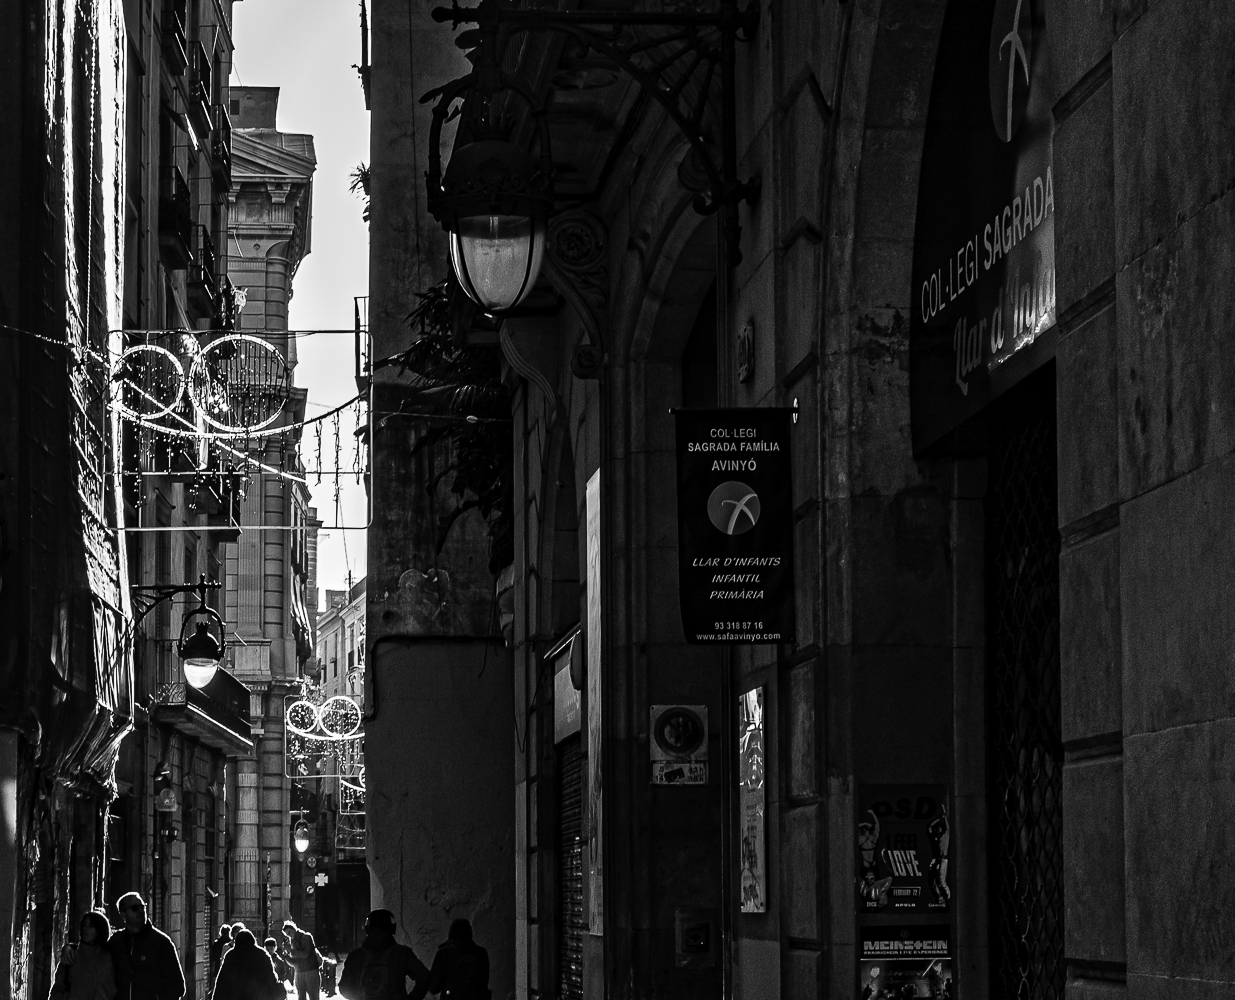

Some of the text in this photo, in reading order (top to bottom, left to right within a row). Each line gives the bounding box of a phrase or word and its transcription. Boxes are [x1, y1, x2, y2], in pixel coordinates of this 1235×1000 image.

[983, 165, 1054, 271] SAGRADA
[709, 428, 757, 439] COL·LEGI
[687, 440, 780, 452] SAGRADA FAMÍLIA
[711, 457, 757, 471] AVINYÓ
[692, 557, 721, 567] LLAR
[711, 573, 761, 583] INFANTIL
[714, 621, 724, 630] 93
[695, 632, 781, 642] www.safaavinyo.com
[887, 850, 922, 877] LOVE
